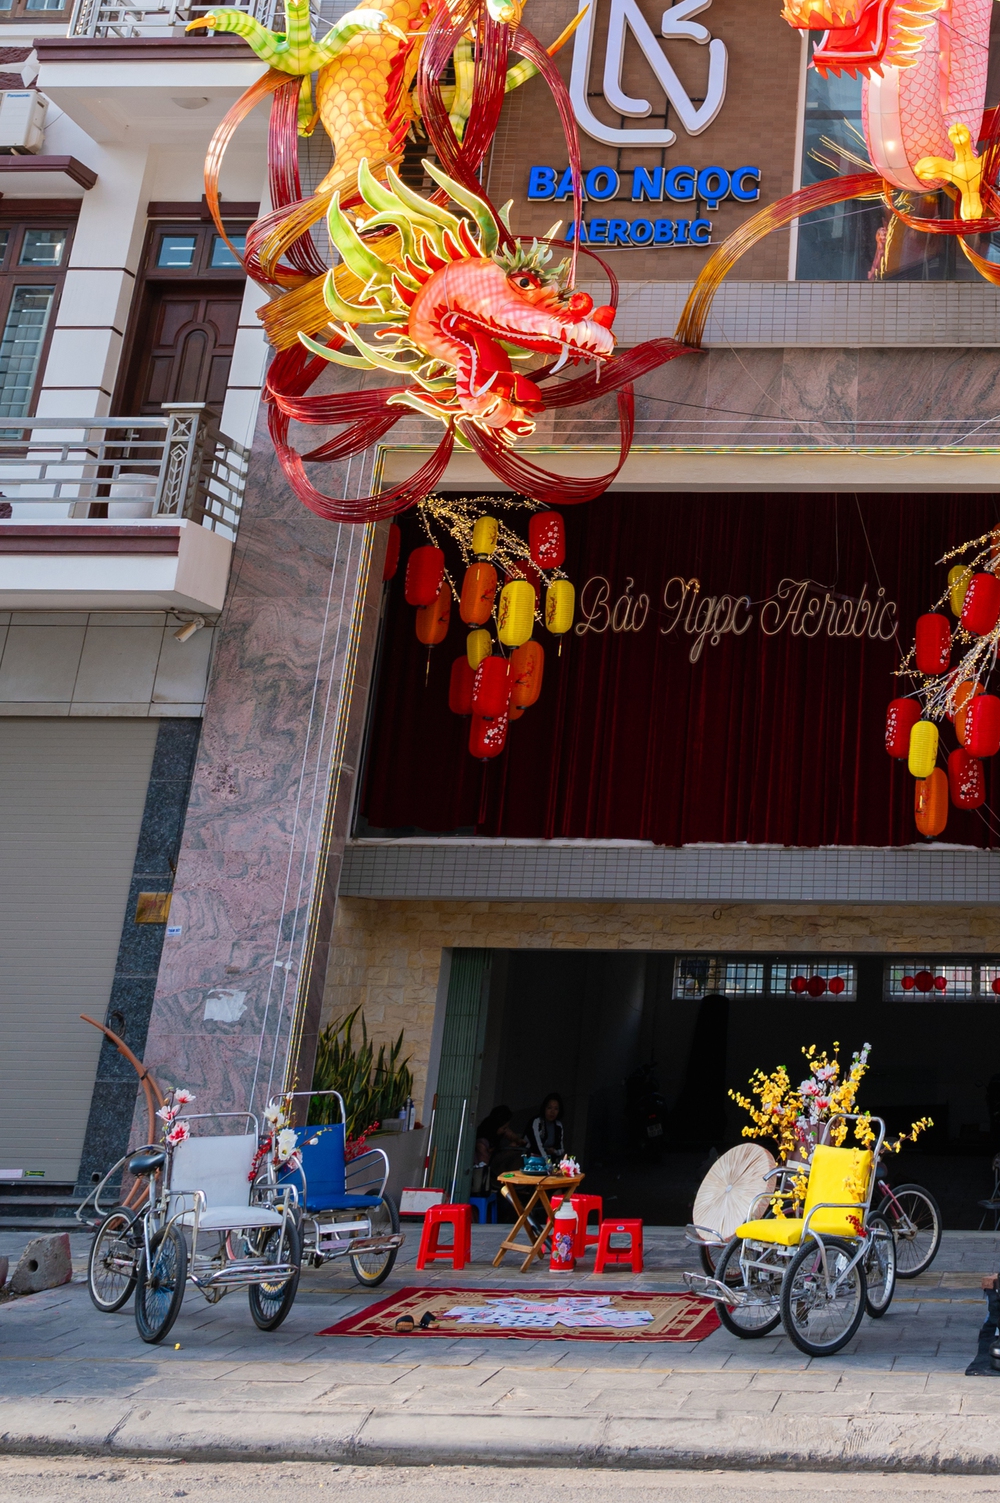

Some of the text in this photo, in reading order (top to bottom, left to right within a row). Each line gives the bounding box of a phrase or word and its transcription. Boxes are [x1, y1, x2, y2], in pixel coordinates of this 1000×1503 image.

[632, 165, 761, 210] NGỌC
[565, 218, 712, 245] AEROBIC
[575, 575, 650, 637] Bảo
[760, 578, 899, 641] Aerobic
